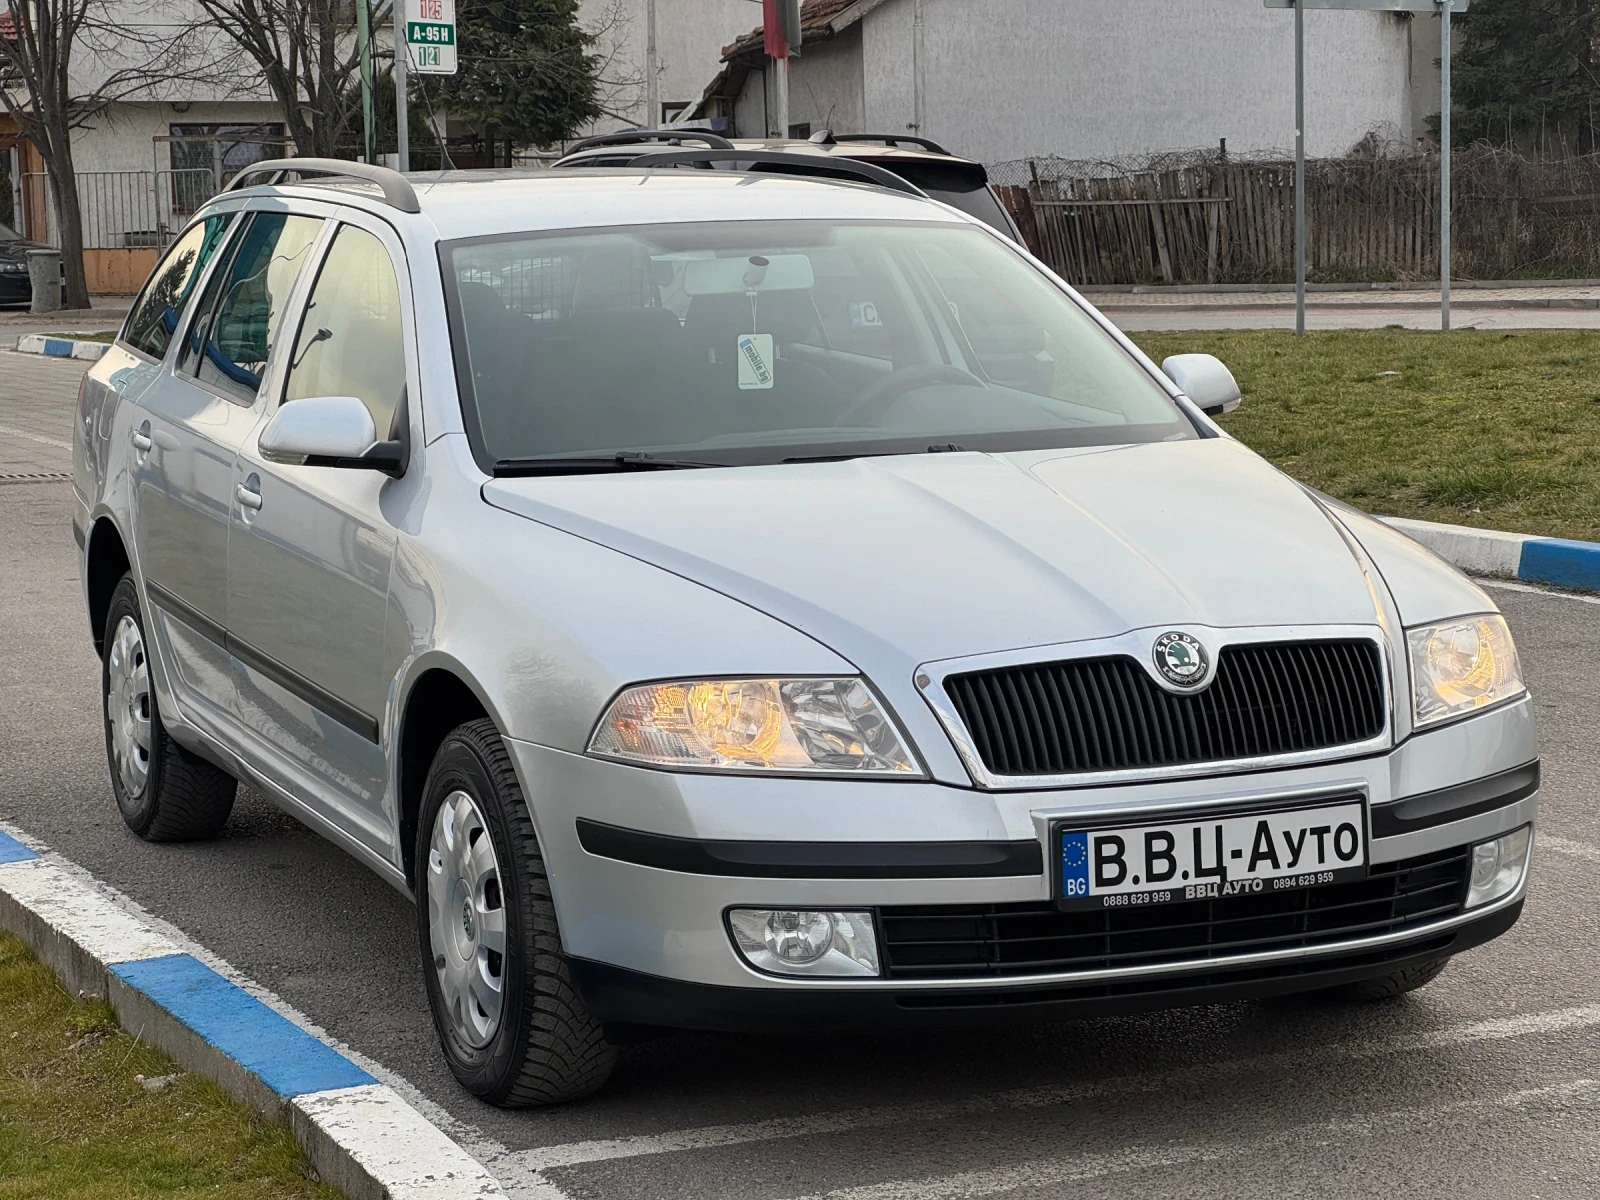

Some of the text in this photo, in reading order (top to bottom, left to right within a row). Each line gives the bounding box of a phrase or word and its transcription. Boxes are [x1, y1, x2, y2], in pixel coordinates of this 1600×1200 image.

[744, 345, 769, 383] mobile.bg
[1067, 878, 1086, 896] BG
[1185, 879, 1264, 899] ВВЦ АУТО
[1273, 871, 1334, 890] 0894 629 959
[1103, 891, 1171, 907] 0888 629 959
